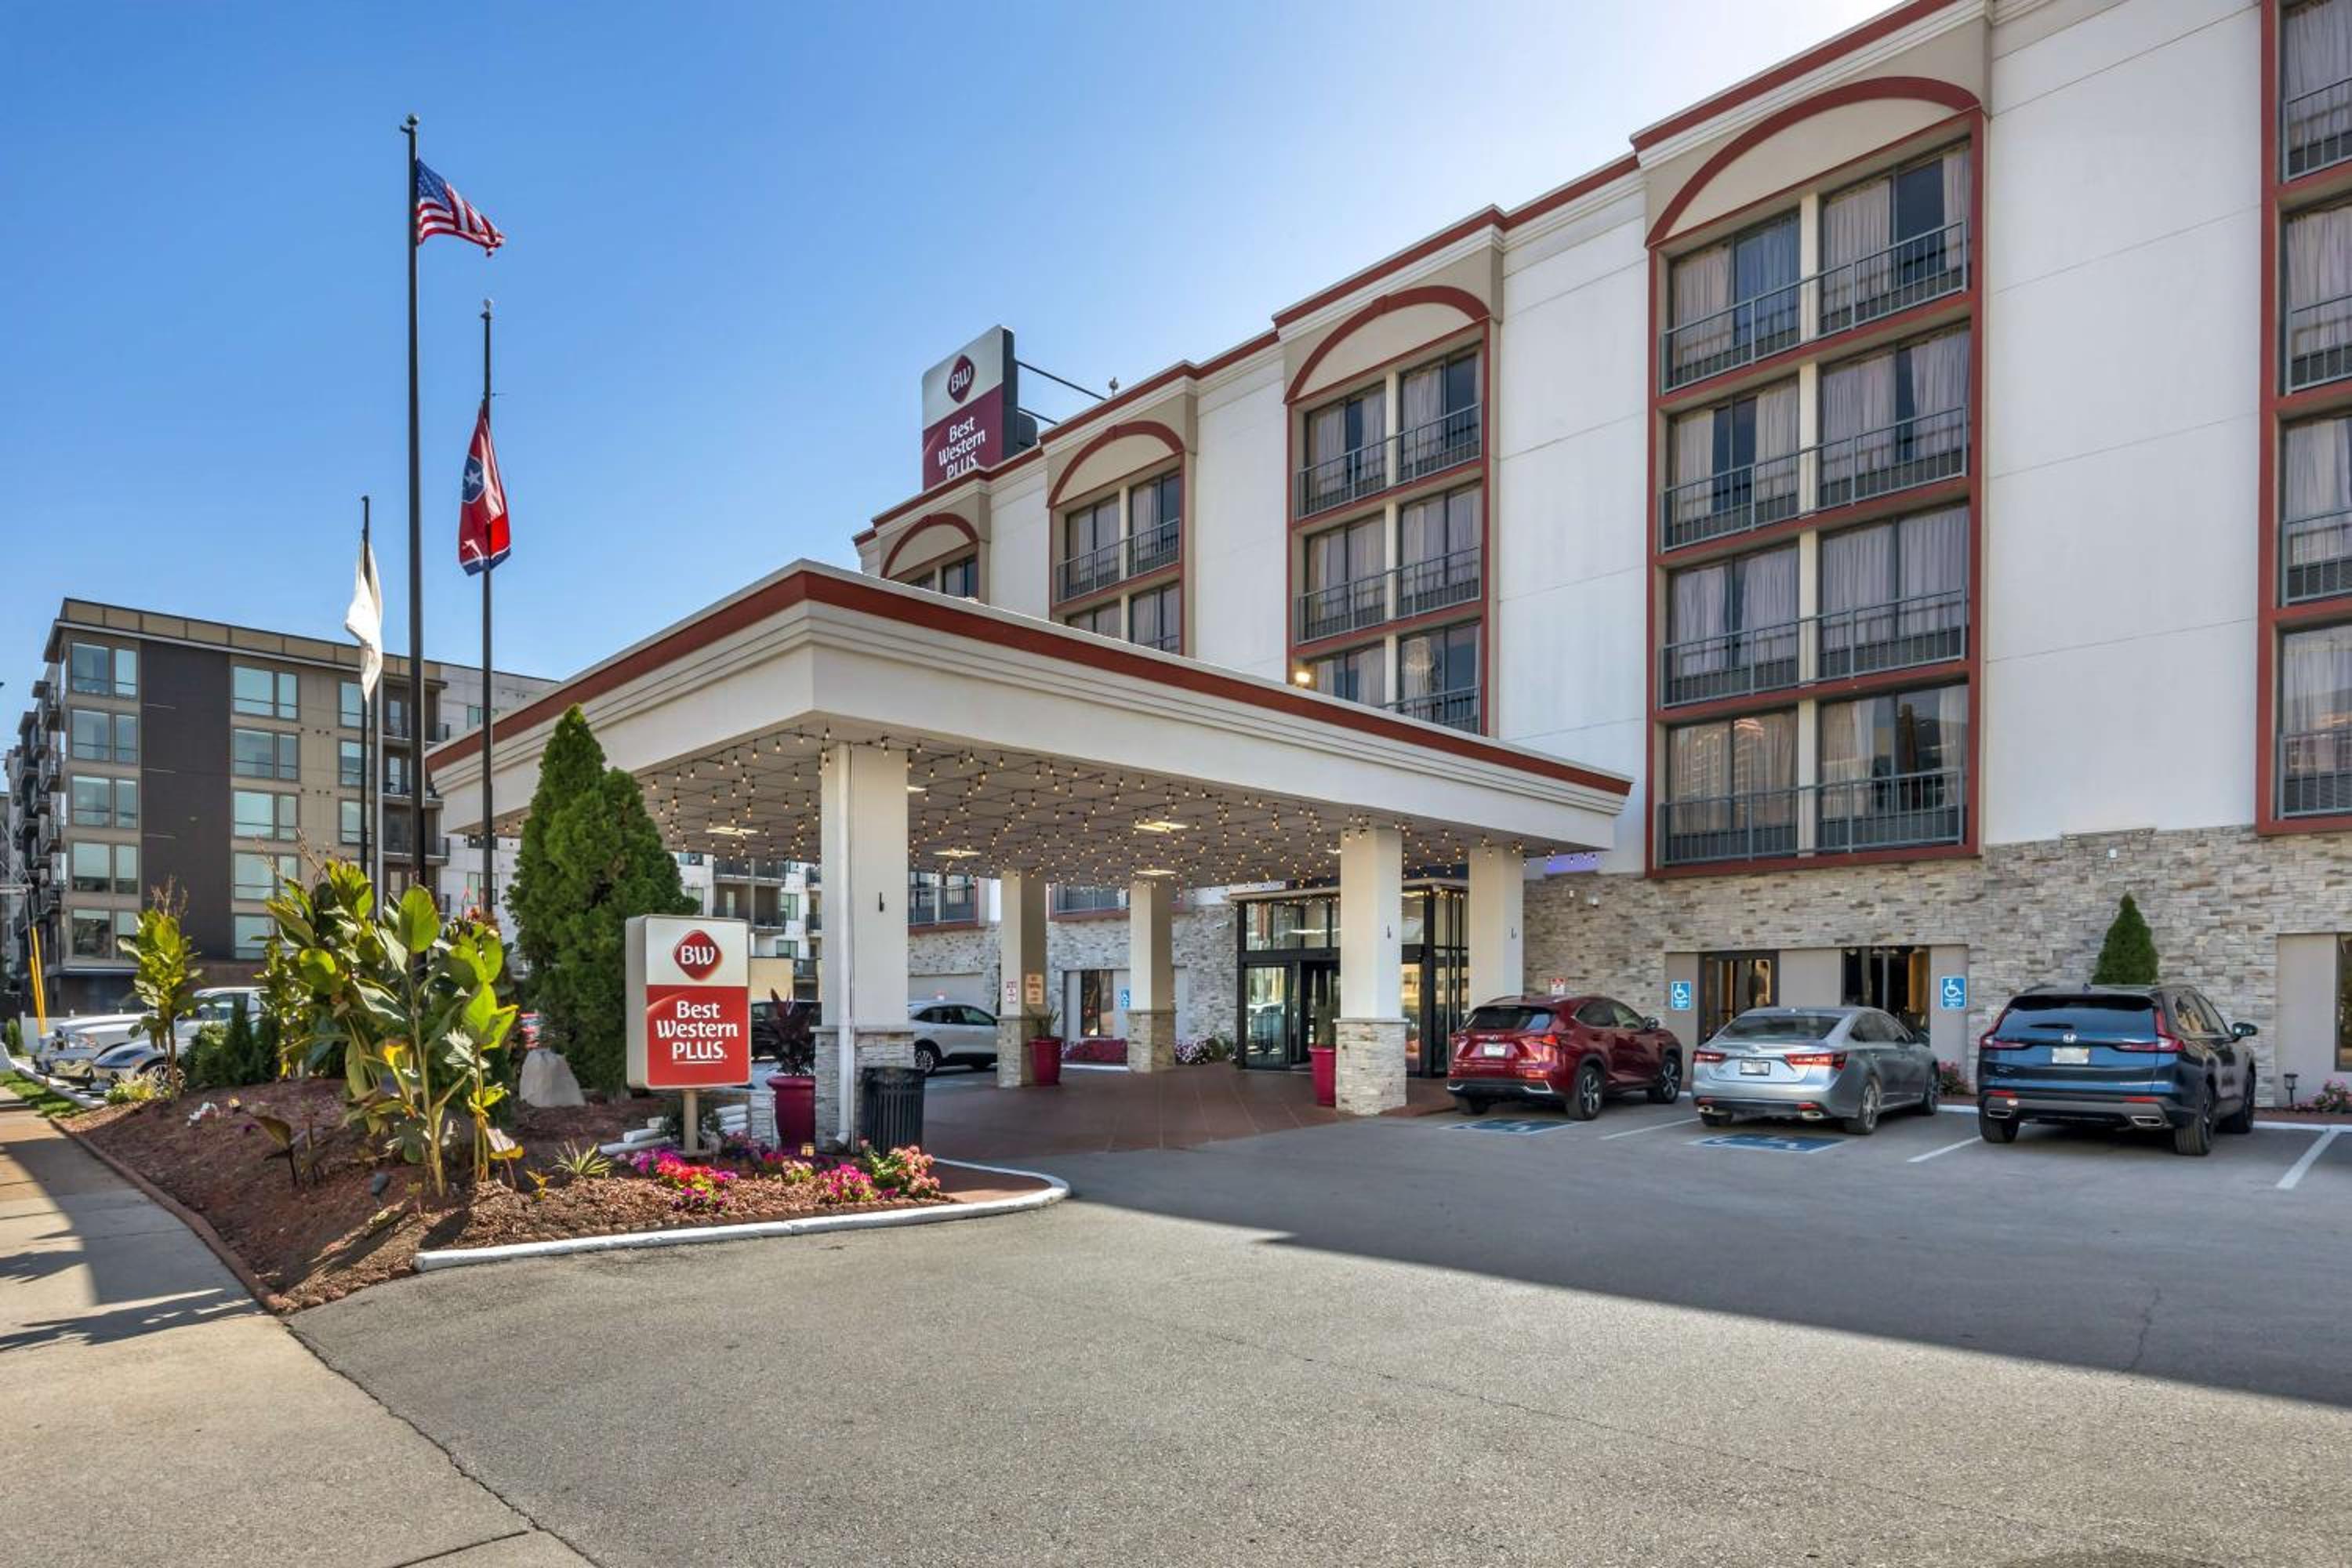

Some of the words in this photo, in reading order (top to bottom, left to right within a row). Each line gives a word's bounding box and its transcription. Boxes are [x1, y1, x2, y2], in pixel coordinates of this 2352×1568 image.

[951, 366, 971, 392] BW
[949, 417, 975, 443] Best
[938, 430, 986, 466] Western
[681, 945, 715, 965] BW
[677, 1000, 720, 1018] Best
[656, 1019, 739, 1039] Western
